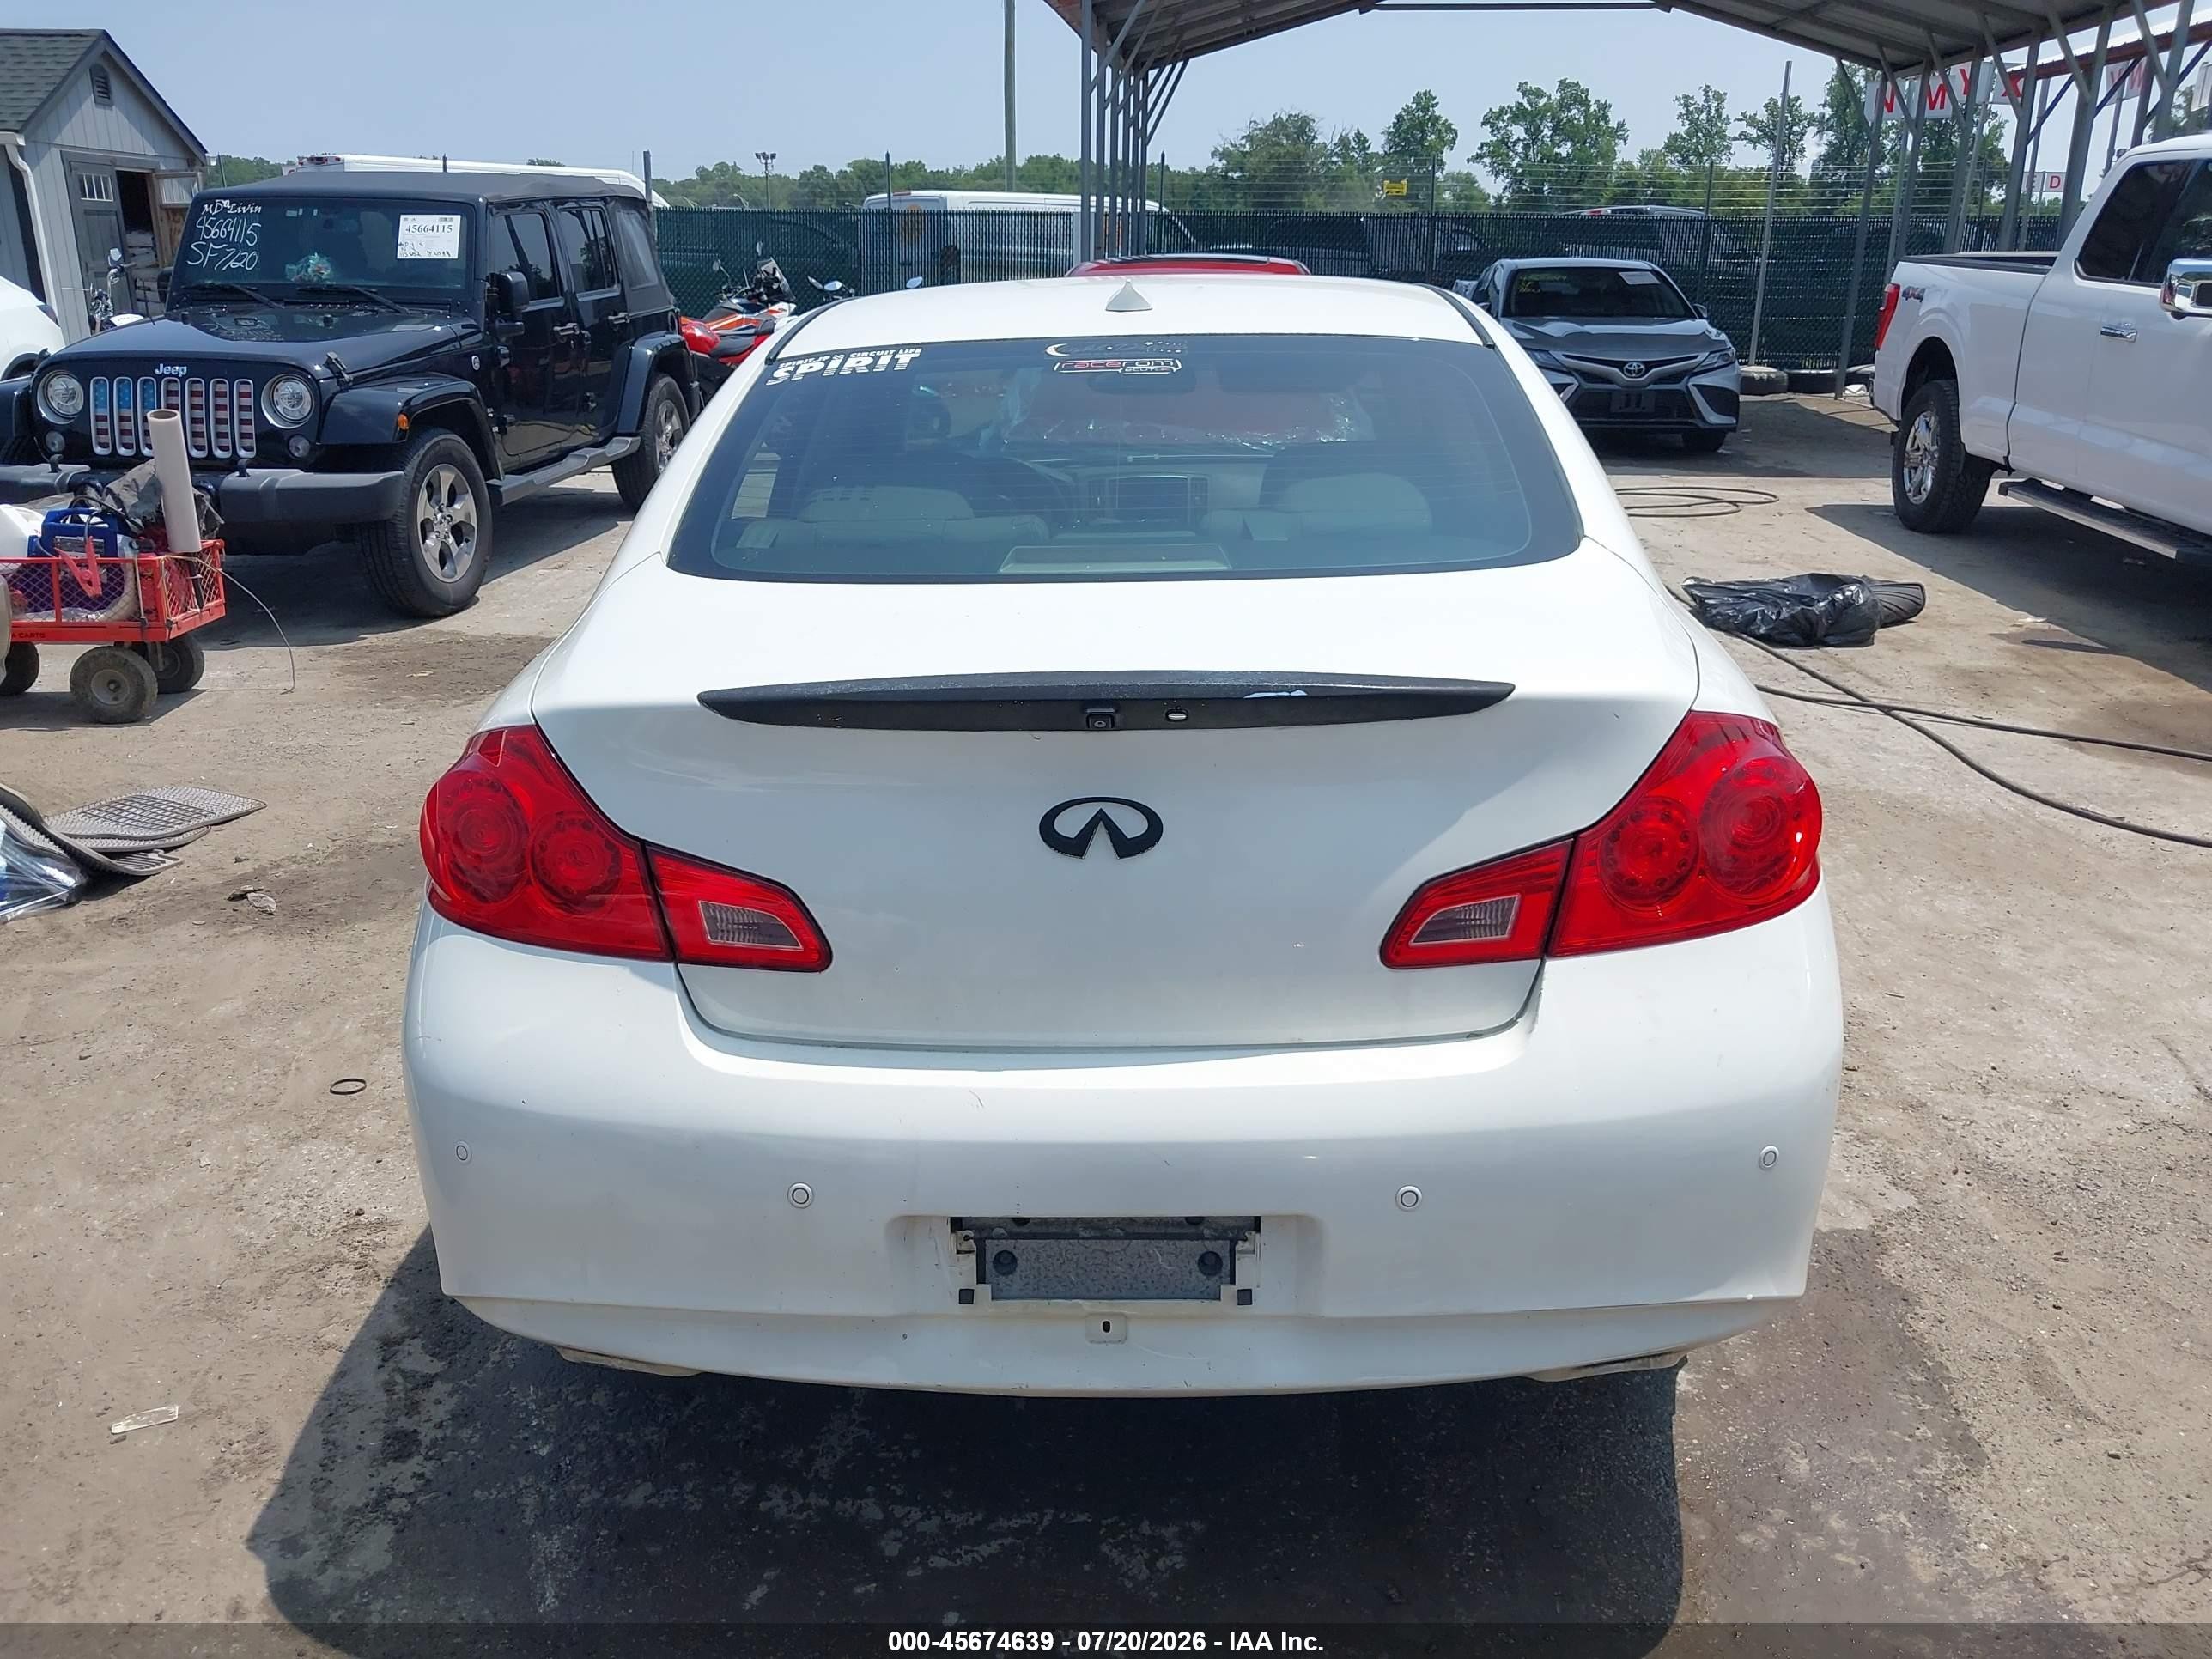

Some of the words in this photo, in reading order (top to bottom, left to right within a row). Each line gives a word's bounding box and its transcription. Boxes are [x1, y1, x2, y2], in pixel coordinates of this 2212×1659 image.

[2050, 175, 2061, 188] D
[196, 216, 262, 246] 45664115
[405, 224, 453, 234] 45664115
[155, 363, 187, 377] Jeep
[766, 353, 921, 386] SPIRIT
